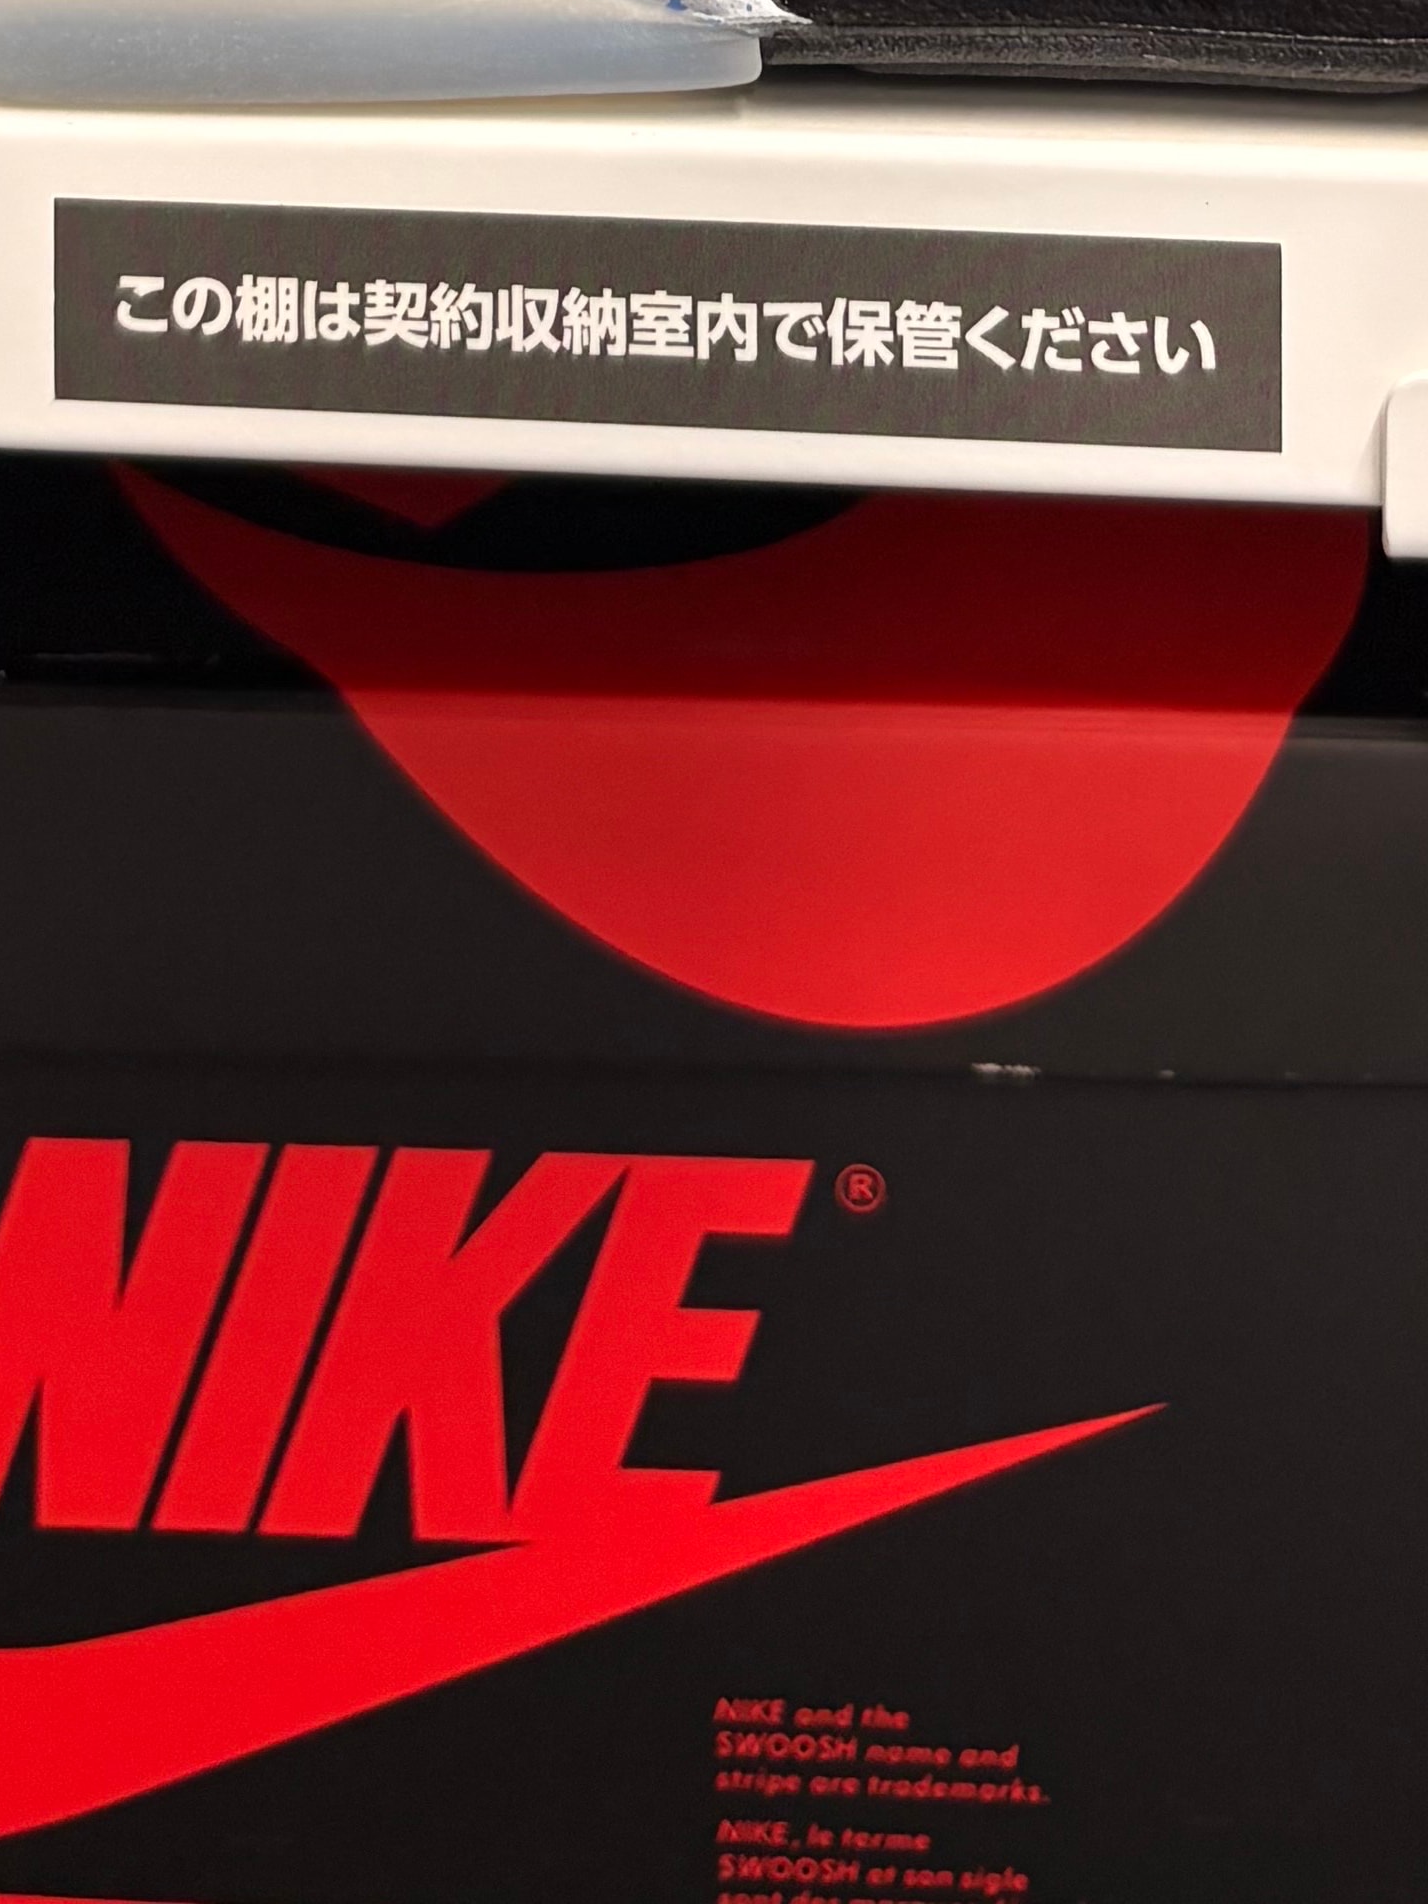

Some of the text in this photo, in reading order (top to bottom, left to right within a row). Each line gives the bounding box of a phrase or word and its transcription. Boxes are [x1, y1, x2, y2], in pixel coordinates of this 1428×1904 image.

[113, 270, 1216, 378] この棚は契約収納室内で保管ください
[713, 1697, 910, 1730] NIKE and the
[715, 1730, 1020, 1771] SWOOSH name and
[715, 1768, 802, 1797] stripe
[809, 1776, 860, 1796] are
[806, 1823, 834, 1849] le
[840, 1828, 932, 1854] terme
[718, 1853, 861, 1886] SWOOSH
[903, 1869, 954, 1889] son
[959, 1866, 1029, 1897] sigle
